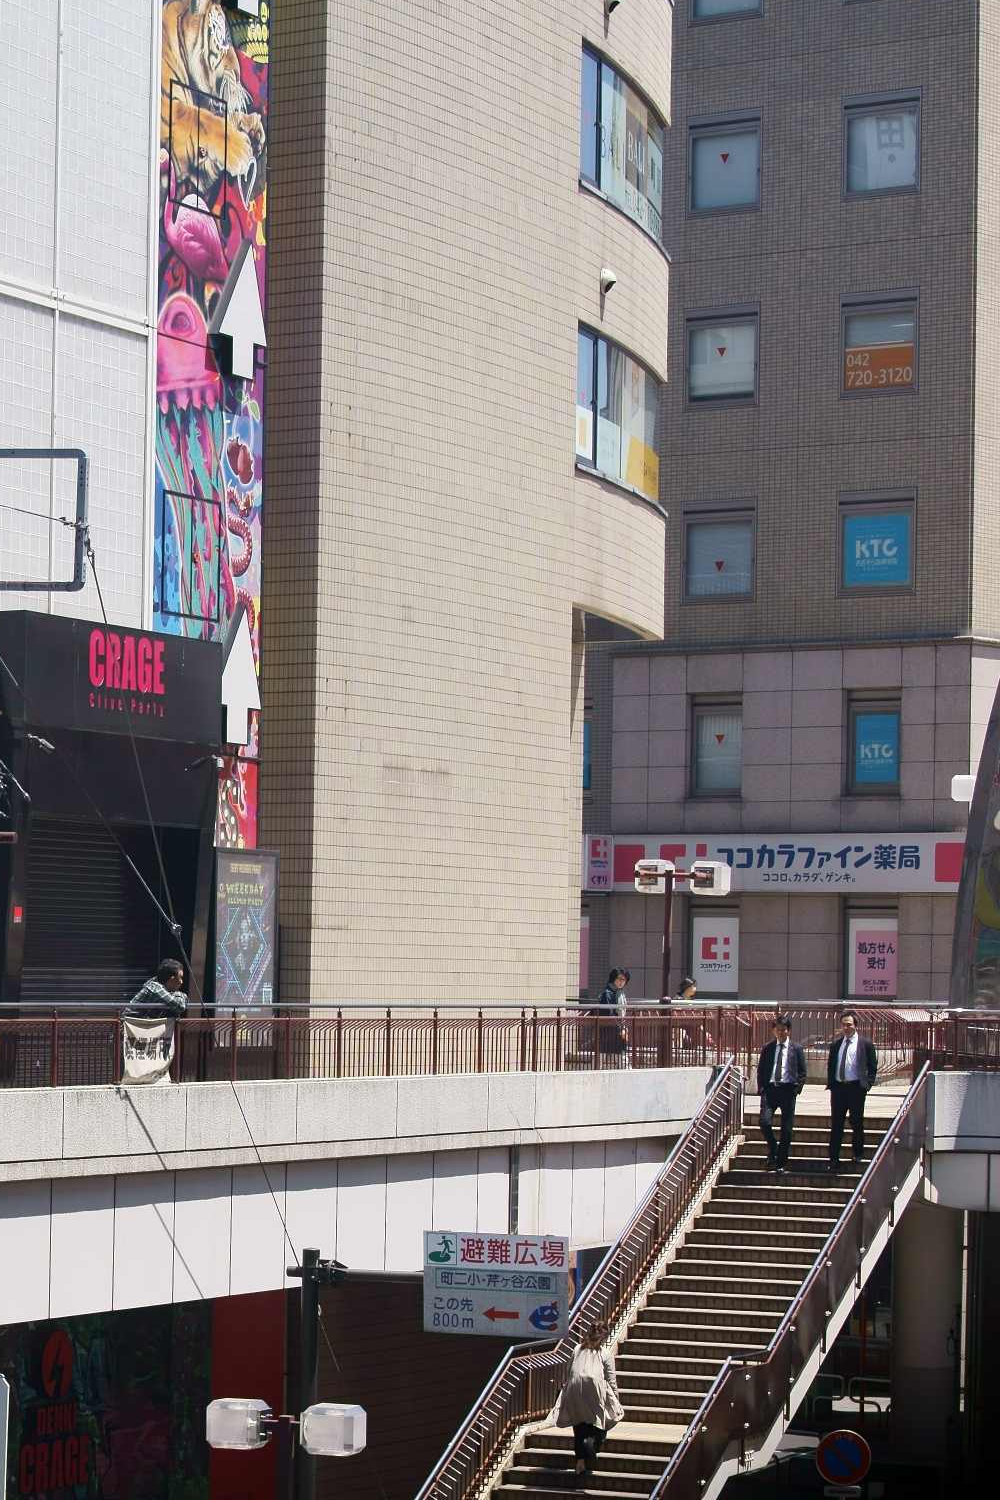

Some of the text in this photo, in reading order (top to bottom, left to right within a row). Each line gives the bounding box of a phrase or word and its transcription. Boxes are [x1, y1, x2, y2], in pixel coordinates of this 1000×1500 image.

[846, 353, 870, 367] 042
[846, 367, 913, 387] 720-3120
[88, 628, 165, 695] CRAGE
[716, 844, 921, 870] ココカラファイン薬局
[867, 957, 886, 970] 受付
[460, 1238, 565, 1267] 避難広場
[433, 1297, 473, 1312] この先
